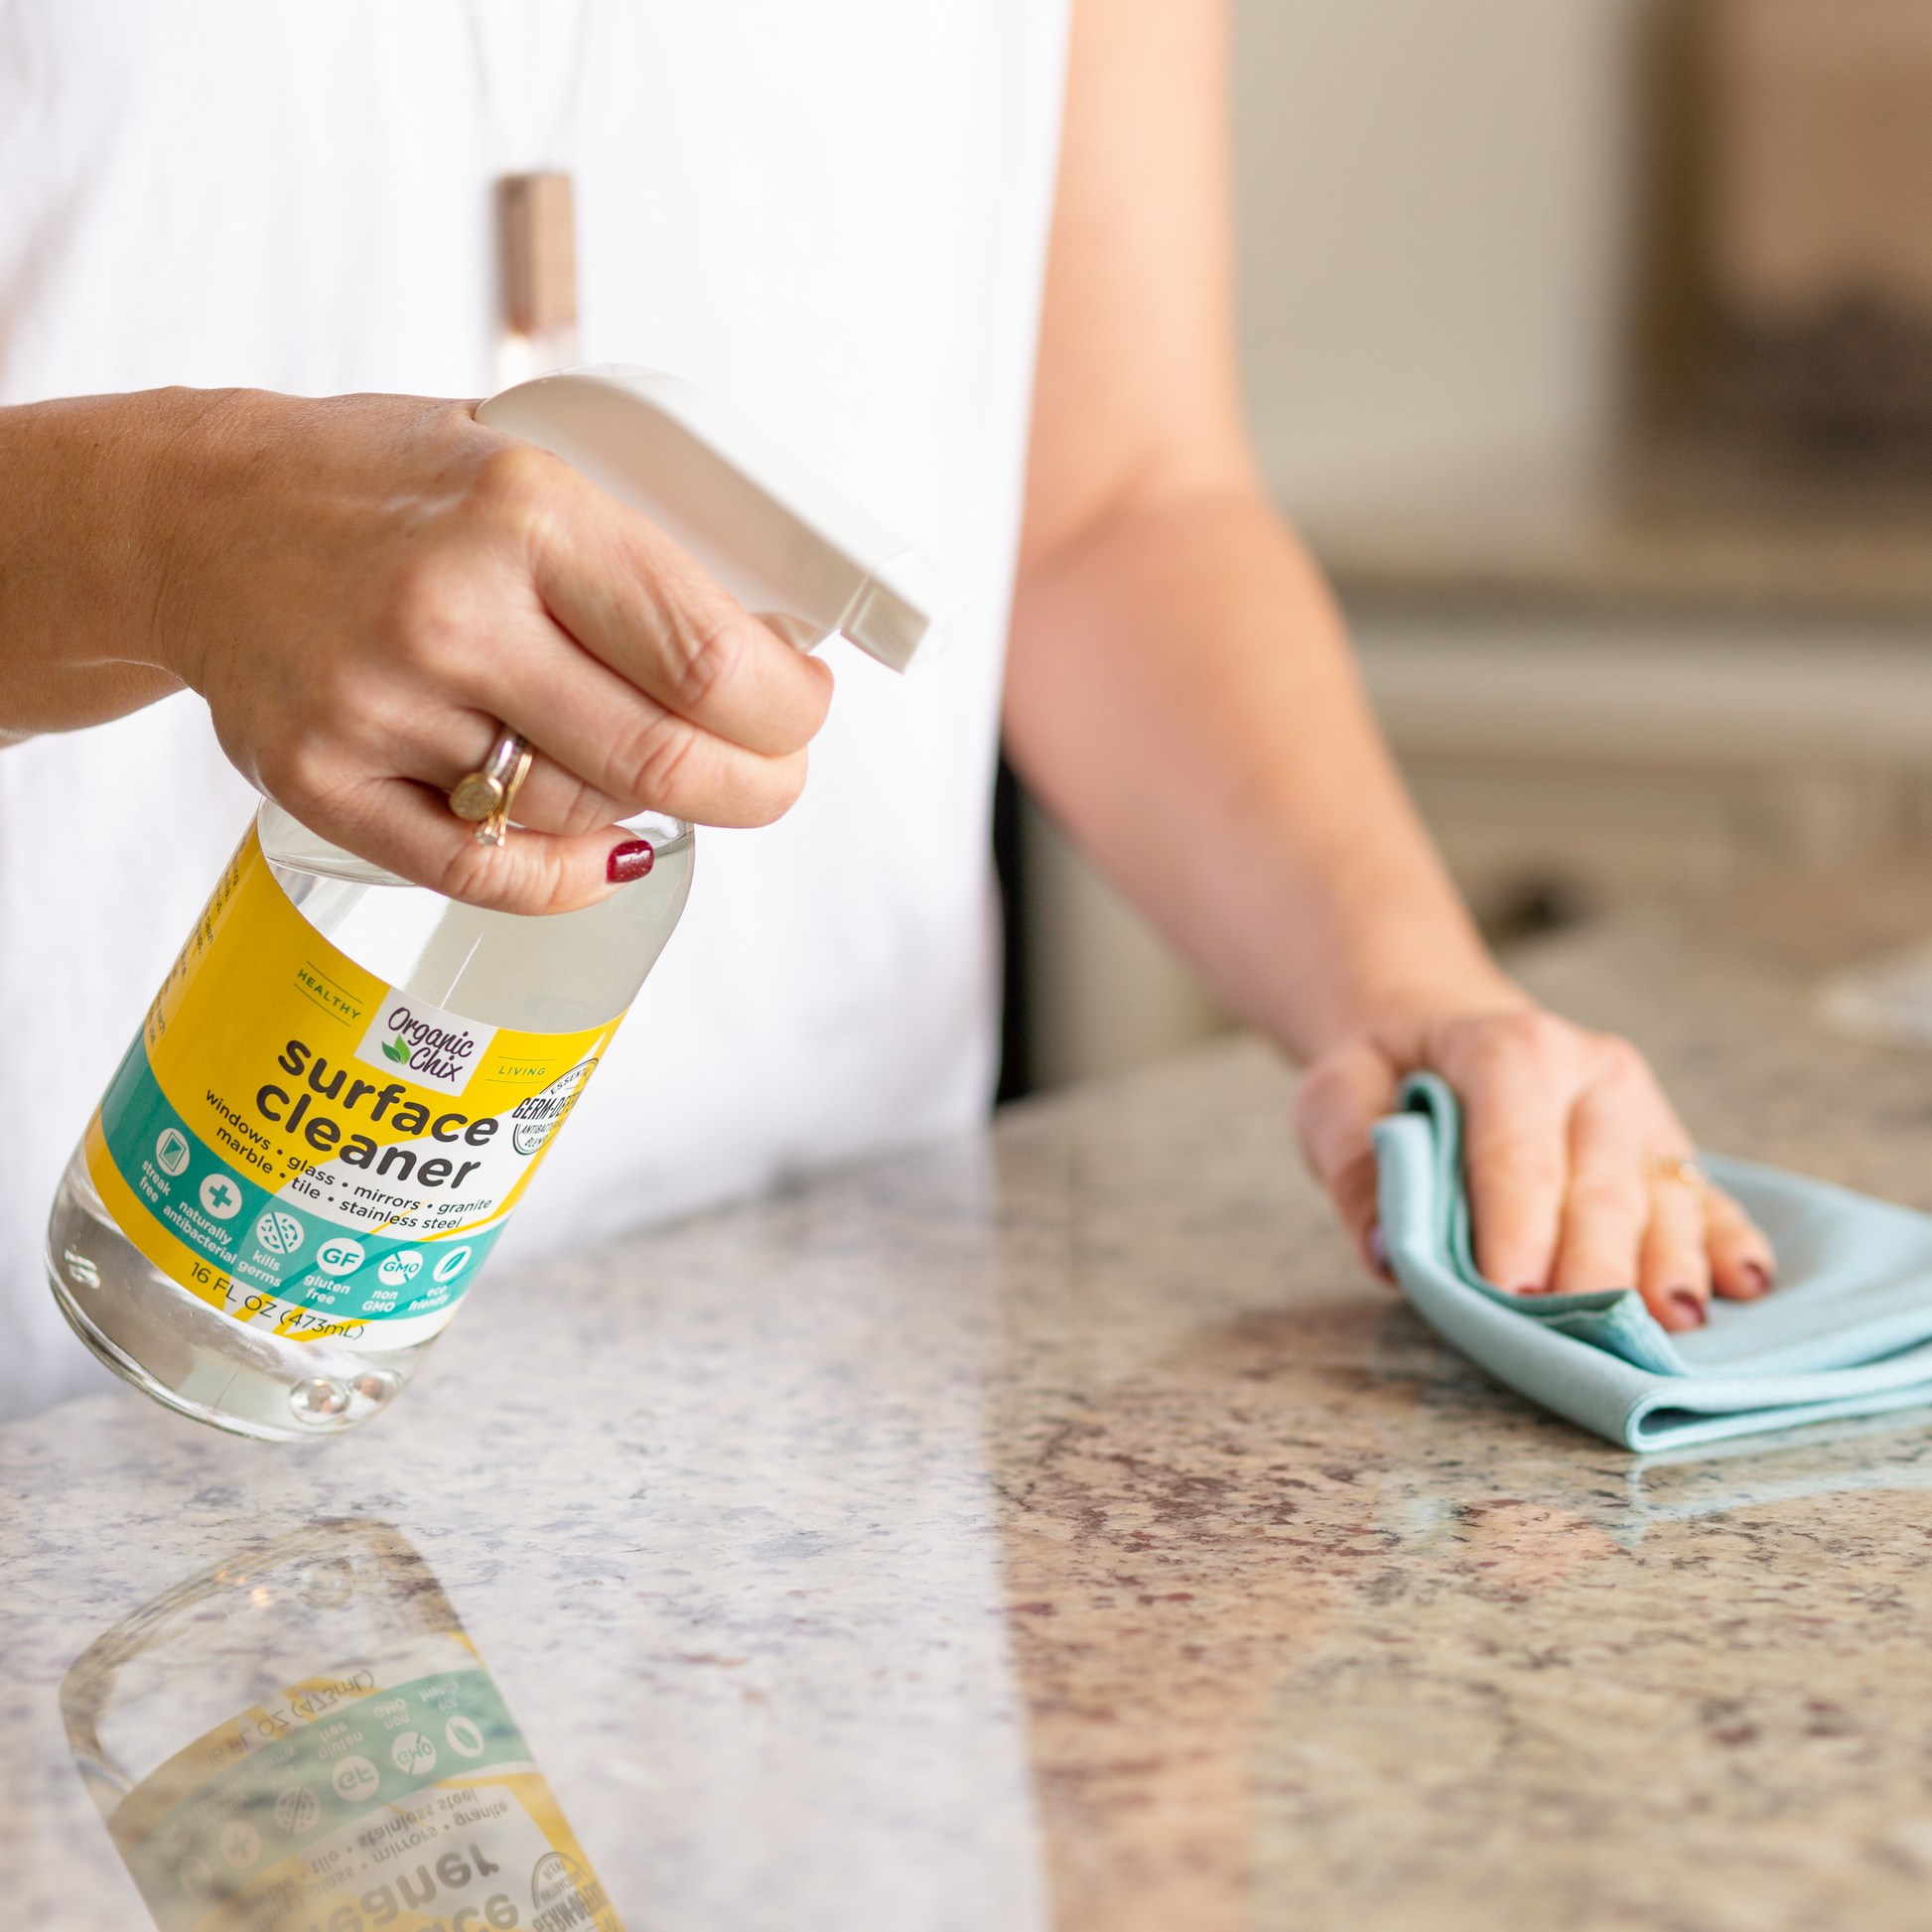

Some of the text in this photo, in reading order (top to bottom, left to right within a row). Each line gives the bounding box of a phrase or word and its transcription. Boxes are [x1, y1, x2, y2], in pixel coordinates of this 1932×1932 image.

[297, 969, 361, 1020] HEALTHY
[387, 1007, 475, 1057] Organic
[409, 1046, 464, 1082] Chix
[498, 1065, 547, 1077] LIVING
[278, 1039, 499, 1147] surface
[255, 1084, 482, 1189] cleaner
[206, 1089, 492, 1215] windows glass mirrors granite
[139, 1176, 159, 1203] free
[141, 1160, 172, 1196] streak
[216, 1127, 464, 1229] marble tile stainless steel
[163, 1204, 238, 1265] antibacterial
[178, 1200, 233, 1246] naturally
[251, 1249, 281, 1272] kills
[322, 1247, 360, 1267] GF
[383, 1261, 420, 1274] GMO
[236, 1259, 283, 1288] germs
[303, 1274, 351, 1295] gluten
[191, 1261, 364, 1341] 16 FL OZ (473mL)
[305, 1287, 336, 1305] free
[371, 1290, 399, 1301] non
[408, 1292, 452, 1311] friendly
[427, 1285, 448, 1298] eco
[361, 1301, 396, 1312] GMO
